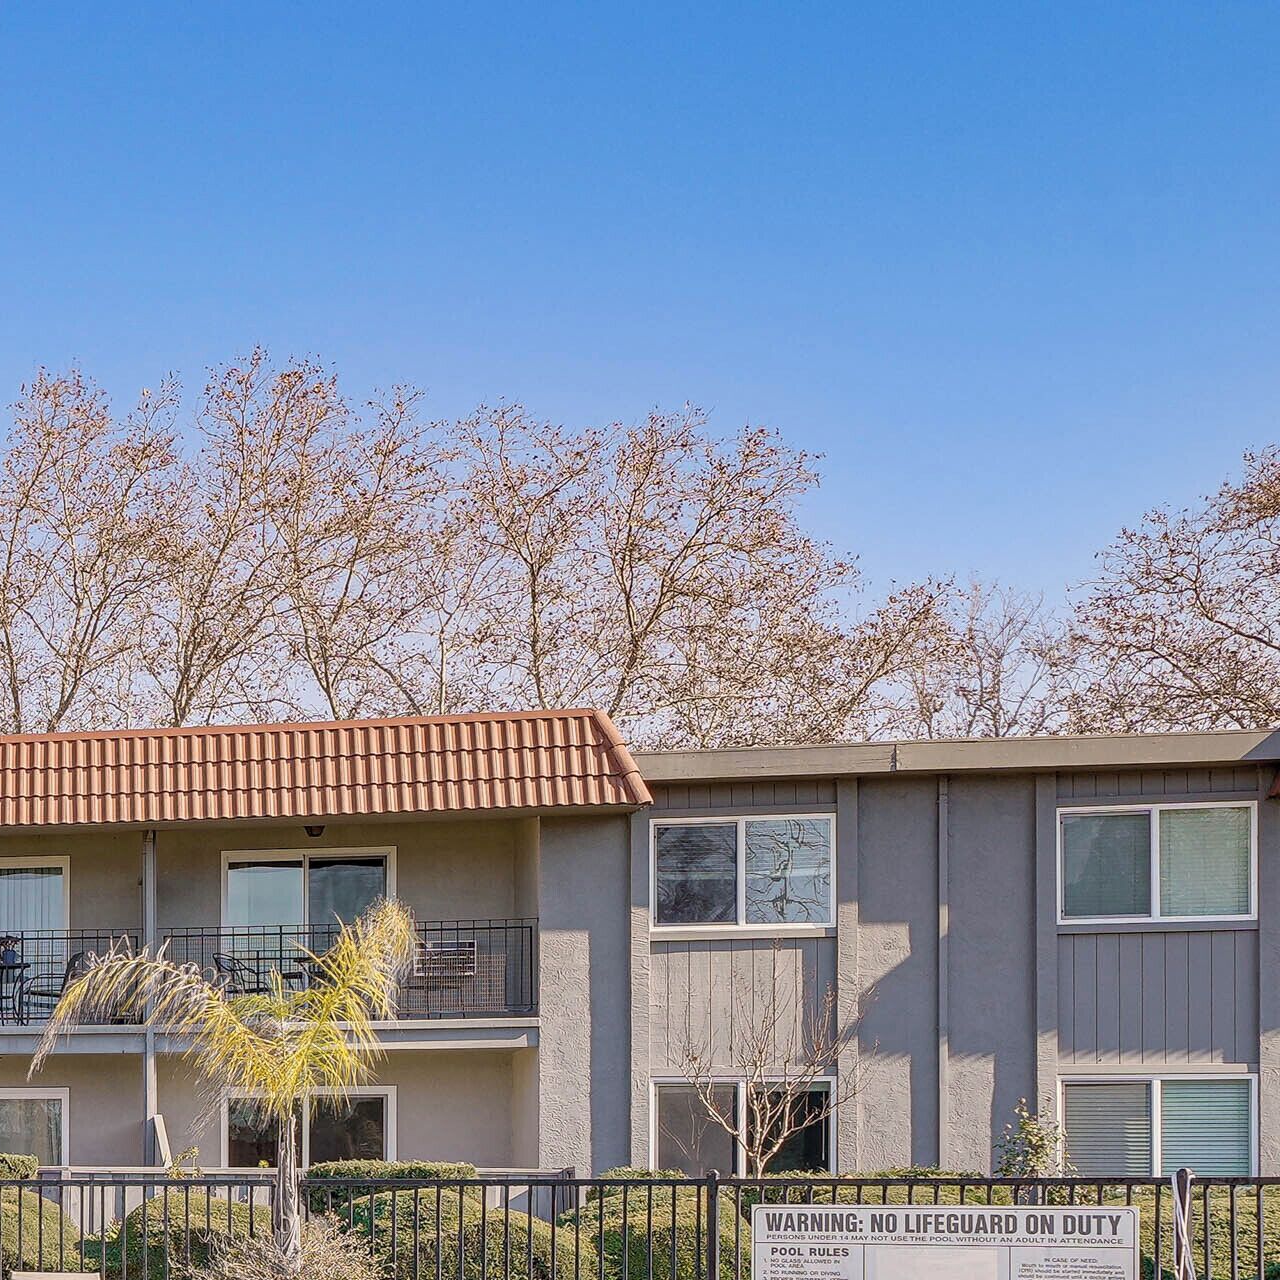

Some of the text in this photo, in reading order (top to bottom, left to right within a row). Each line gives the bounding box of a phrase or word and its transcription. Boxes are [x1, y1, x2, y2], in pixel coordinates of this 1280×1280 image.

[766, 1212, 1122, 1236] WARNING: NO LIFEGUARD ON DUTY
[771, 1247, 849, 1256] POOL RULES
